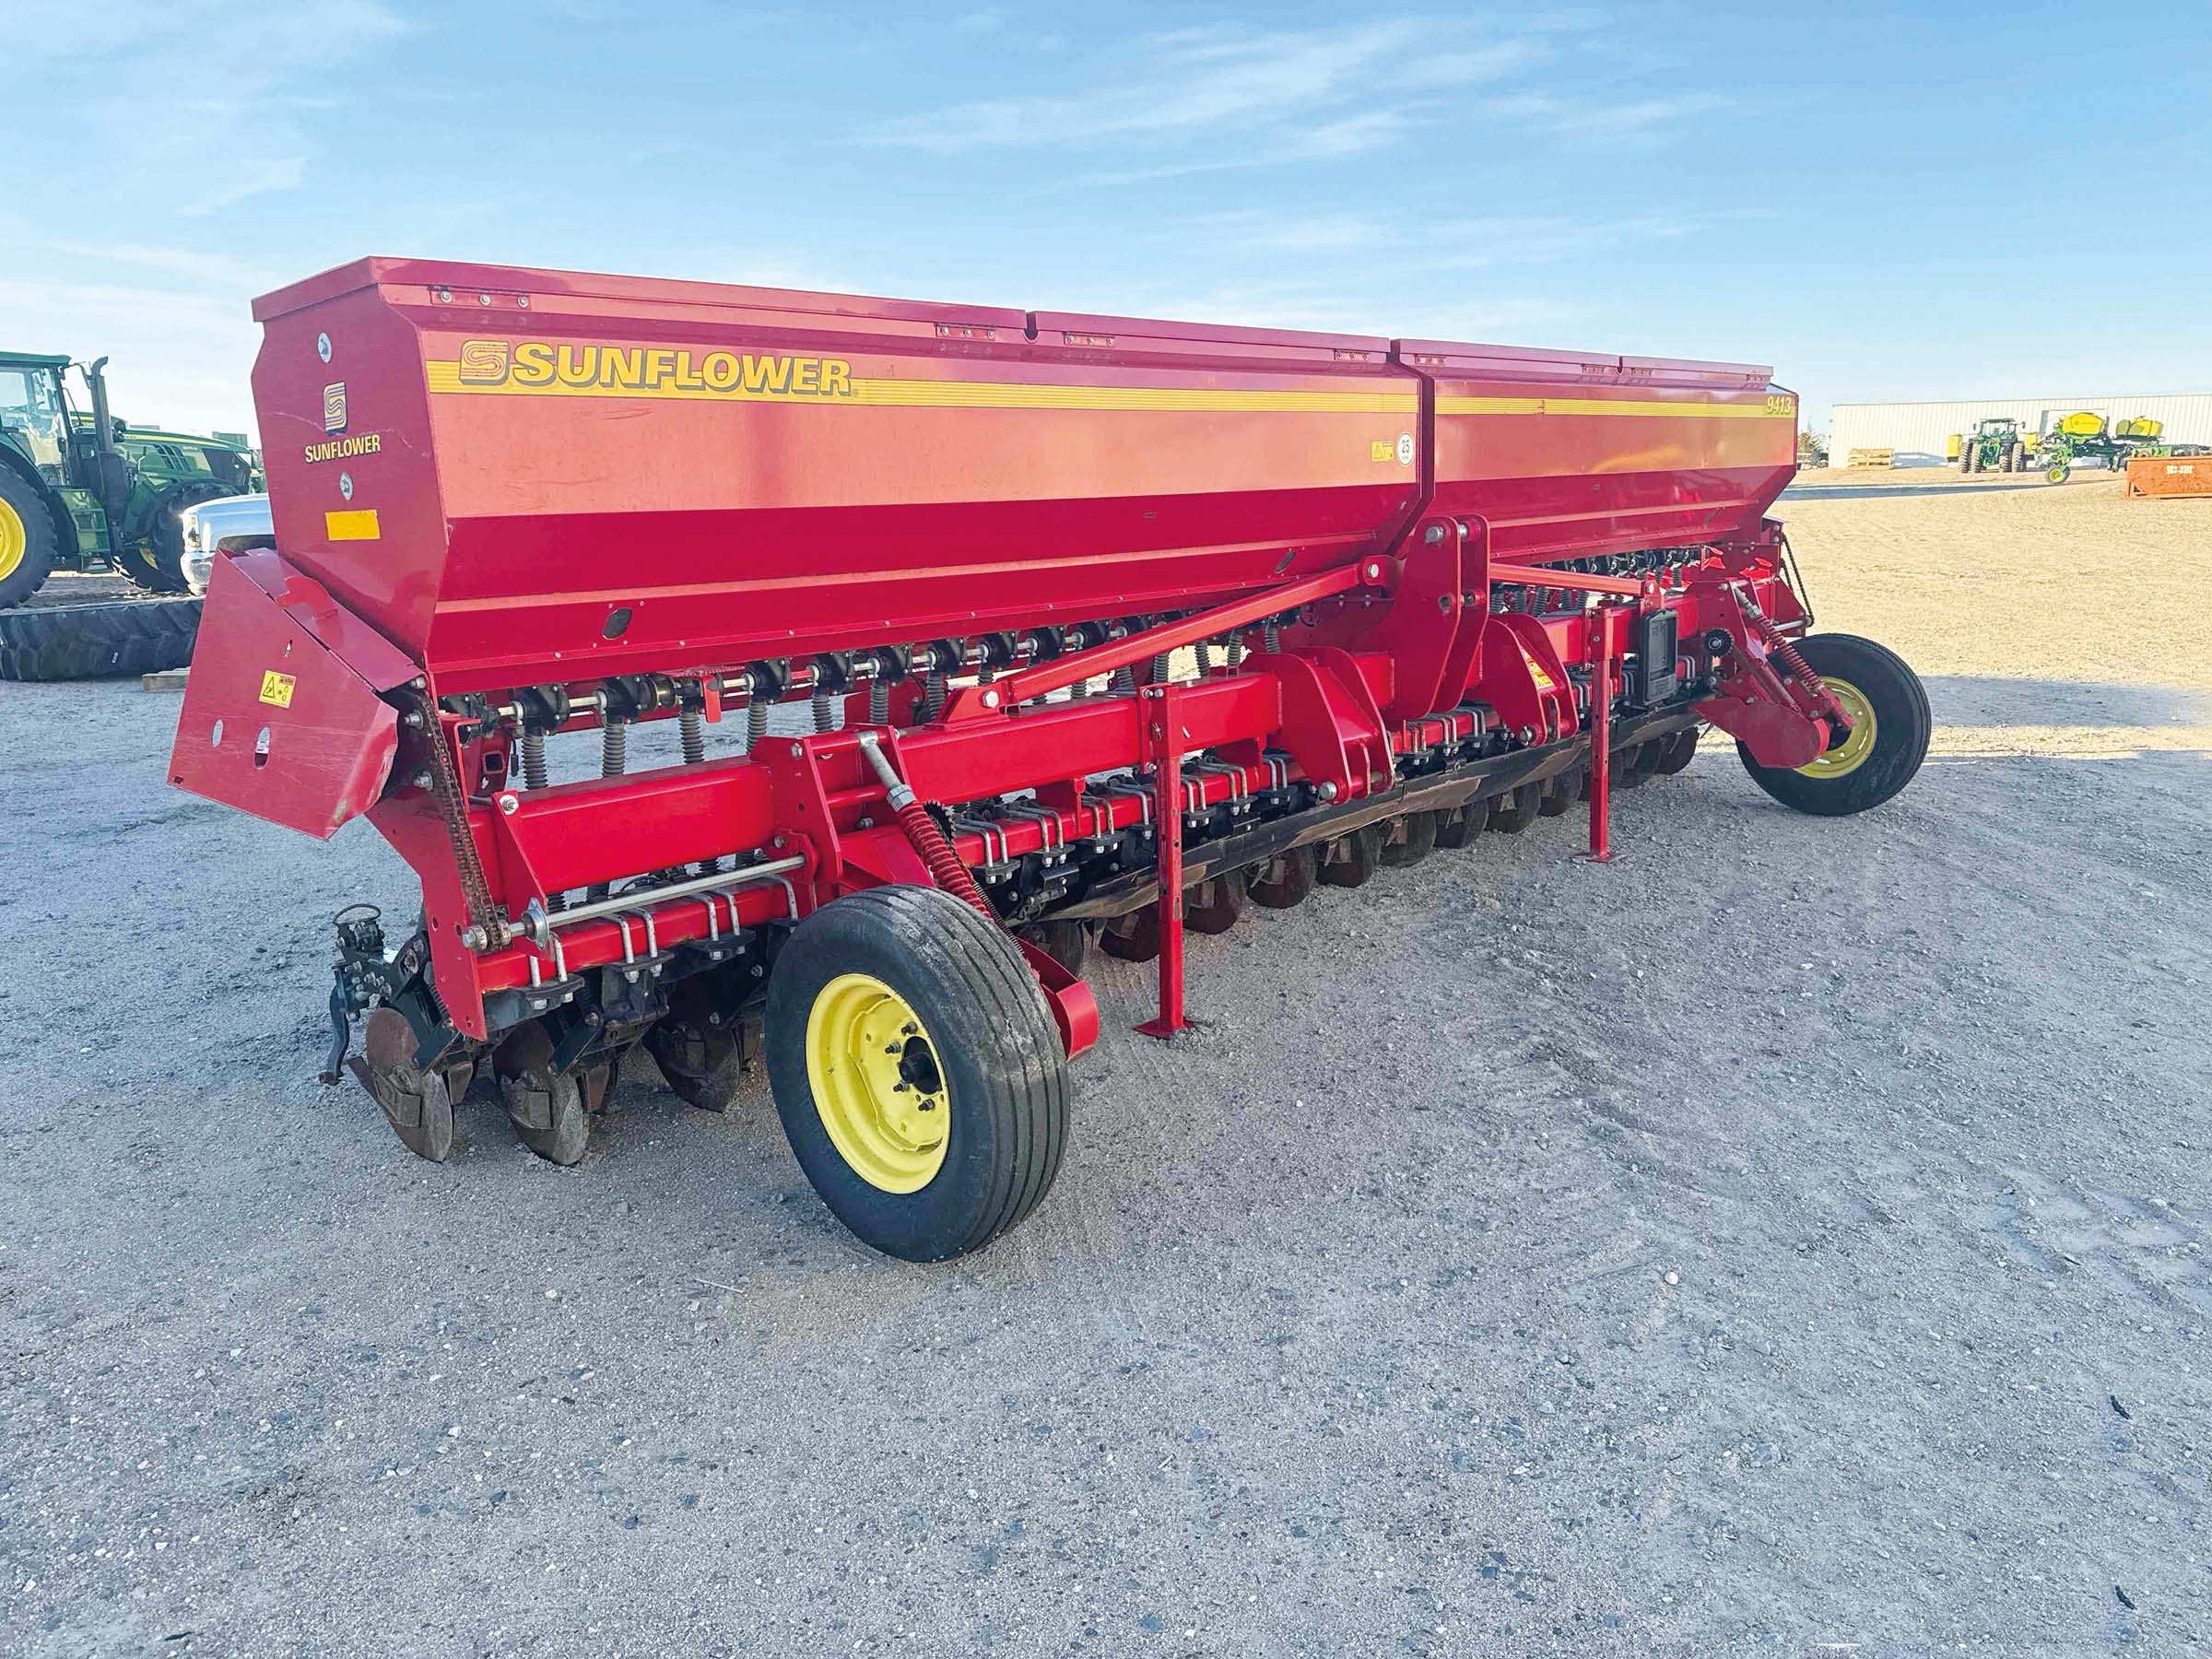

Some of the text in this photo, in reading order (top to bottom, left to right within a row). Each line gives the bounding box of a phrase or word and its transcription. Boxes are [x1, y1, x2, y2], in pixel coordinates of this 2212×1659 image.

[512, 342, 853, 397] SUNFLOWER
[1766, 395, 1793, 415] 9413
[304, 434, 382, 464] SUNFLOWER
[1401, 439, 1410, 453] 25
